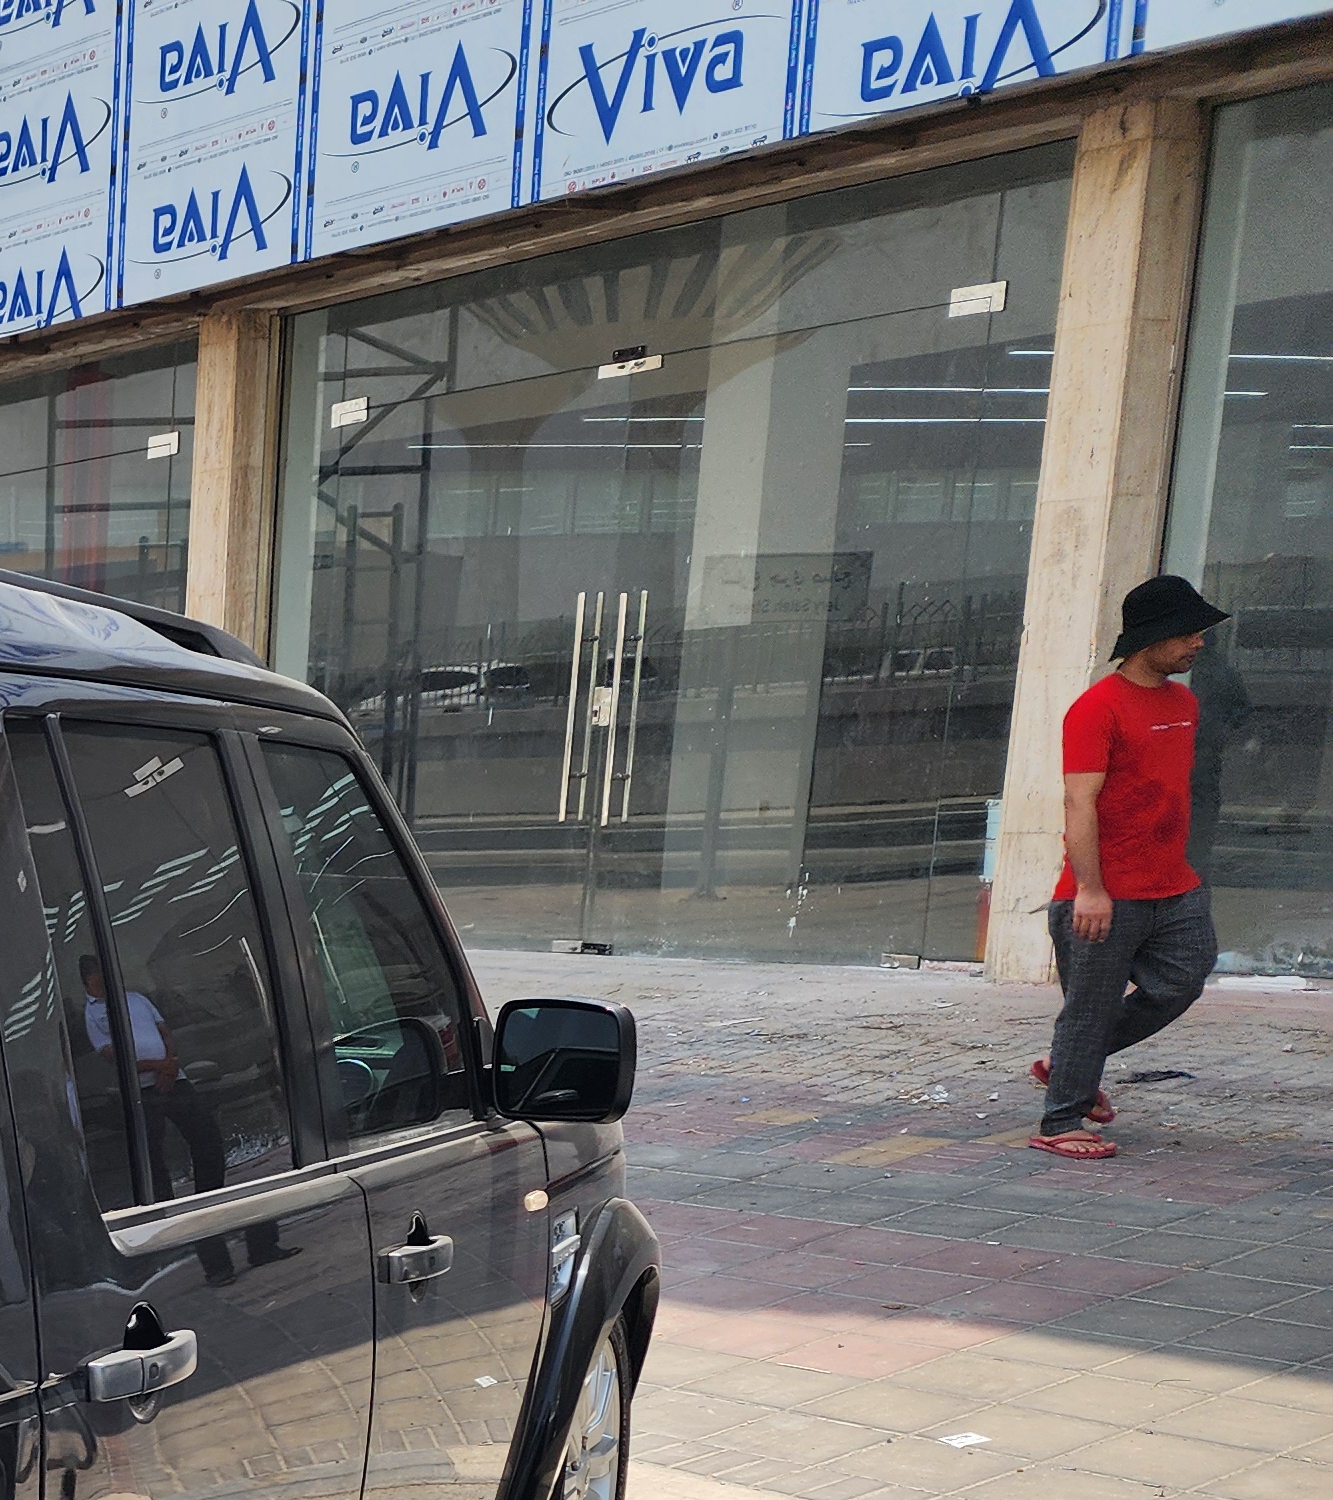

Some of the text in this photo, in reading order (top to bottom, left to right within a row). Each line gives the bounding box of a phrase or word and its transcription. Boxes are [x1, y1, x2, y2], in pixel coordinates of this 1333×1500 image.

[159, 0, 276, 96] Viva
[350, 39, 488, 150] Viva
[578, 27, 744, 147] Viva
[860, 0, 1056, 103] Viva
[152, 161, 268, 262] Viva
